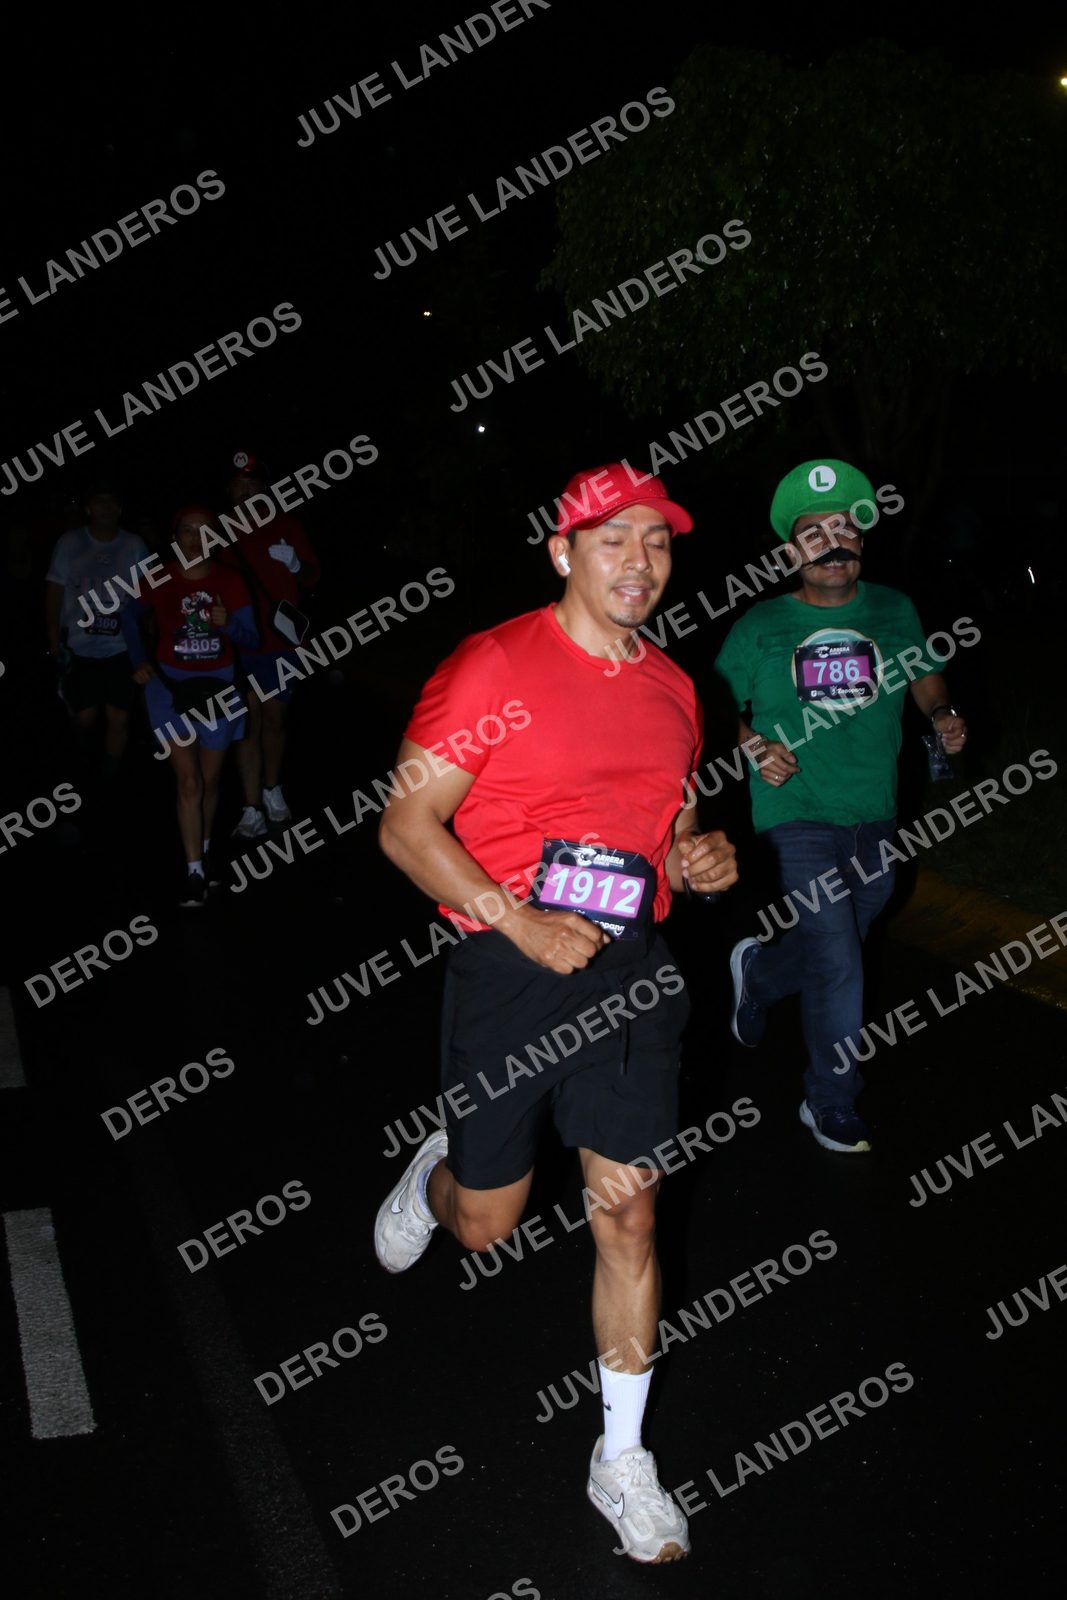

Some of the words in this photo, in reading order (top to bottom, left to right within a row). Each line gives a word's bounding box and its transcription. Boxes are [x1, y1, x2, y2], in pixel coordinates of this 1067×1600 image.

[815, 471, 829, 487] L
[180, 638, 221, 653] 1805
[813, 659, 860, 685] 786
[552, 868, 641, 914] 1912
